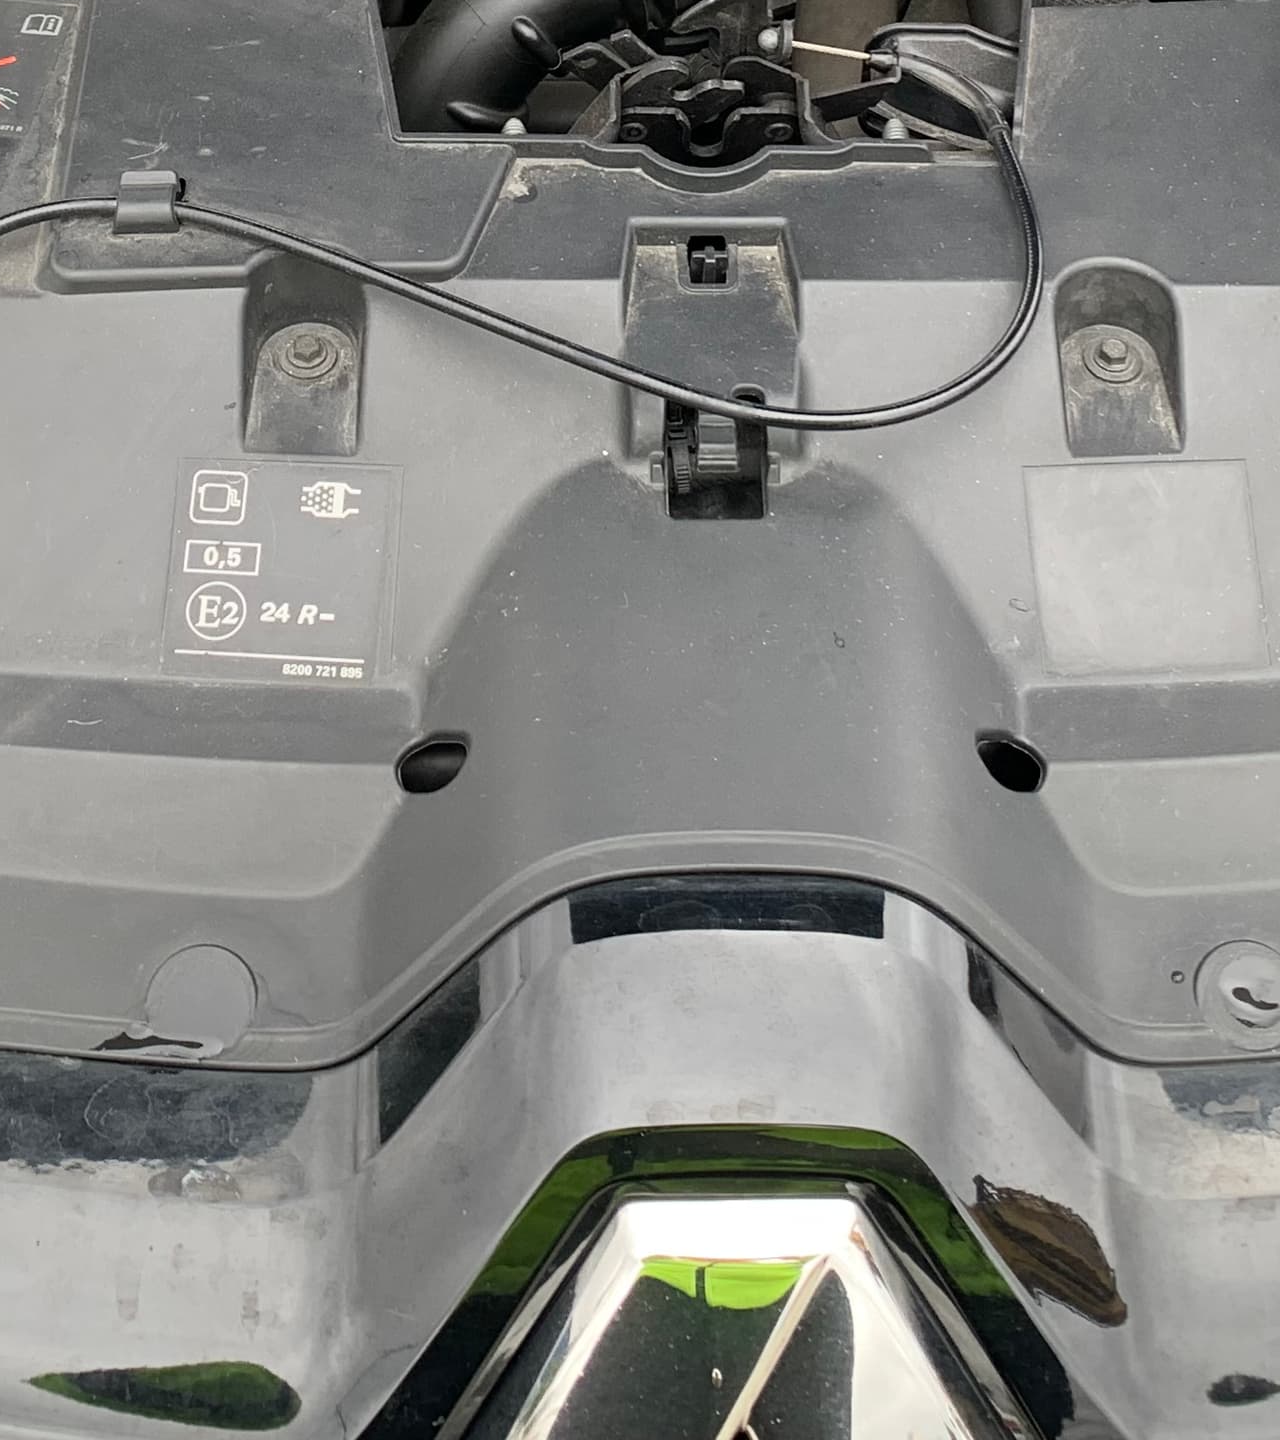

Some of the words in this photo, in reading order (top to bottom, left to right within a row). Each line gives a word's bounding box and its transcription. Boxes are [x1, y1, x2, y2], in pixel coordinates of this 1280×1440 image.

[203, 546, 241, 569] 0,5
[195, 594, 240, 629] E2
[260, 602, 291, 623] 24
[282, 663, 313, 676] 8200
[315, 665, 337, 678] 721
